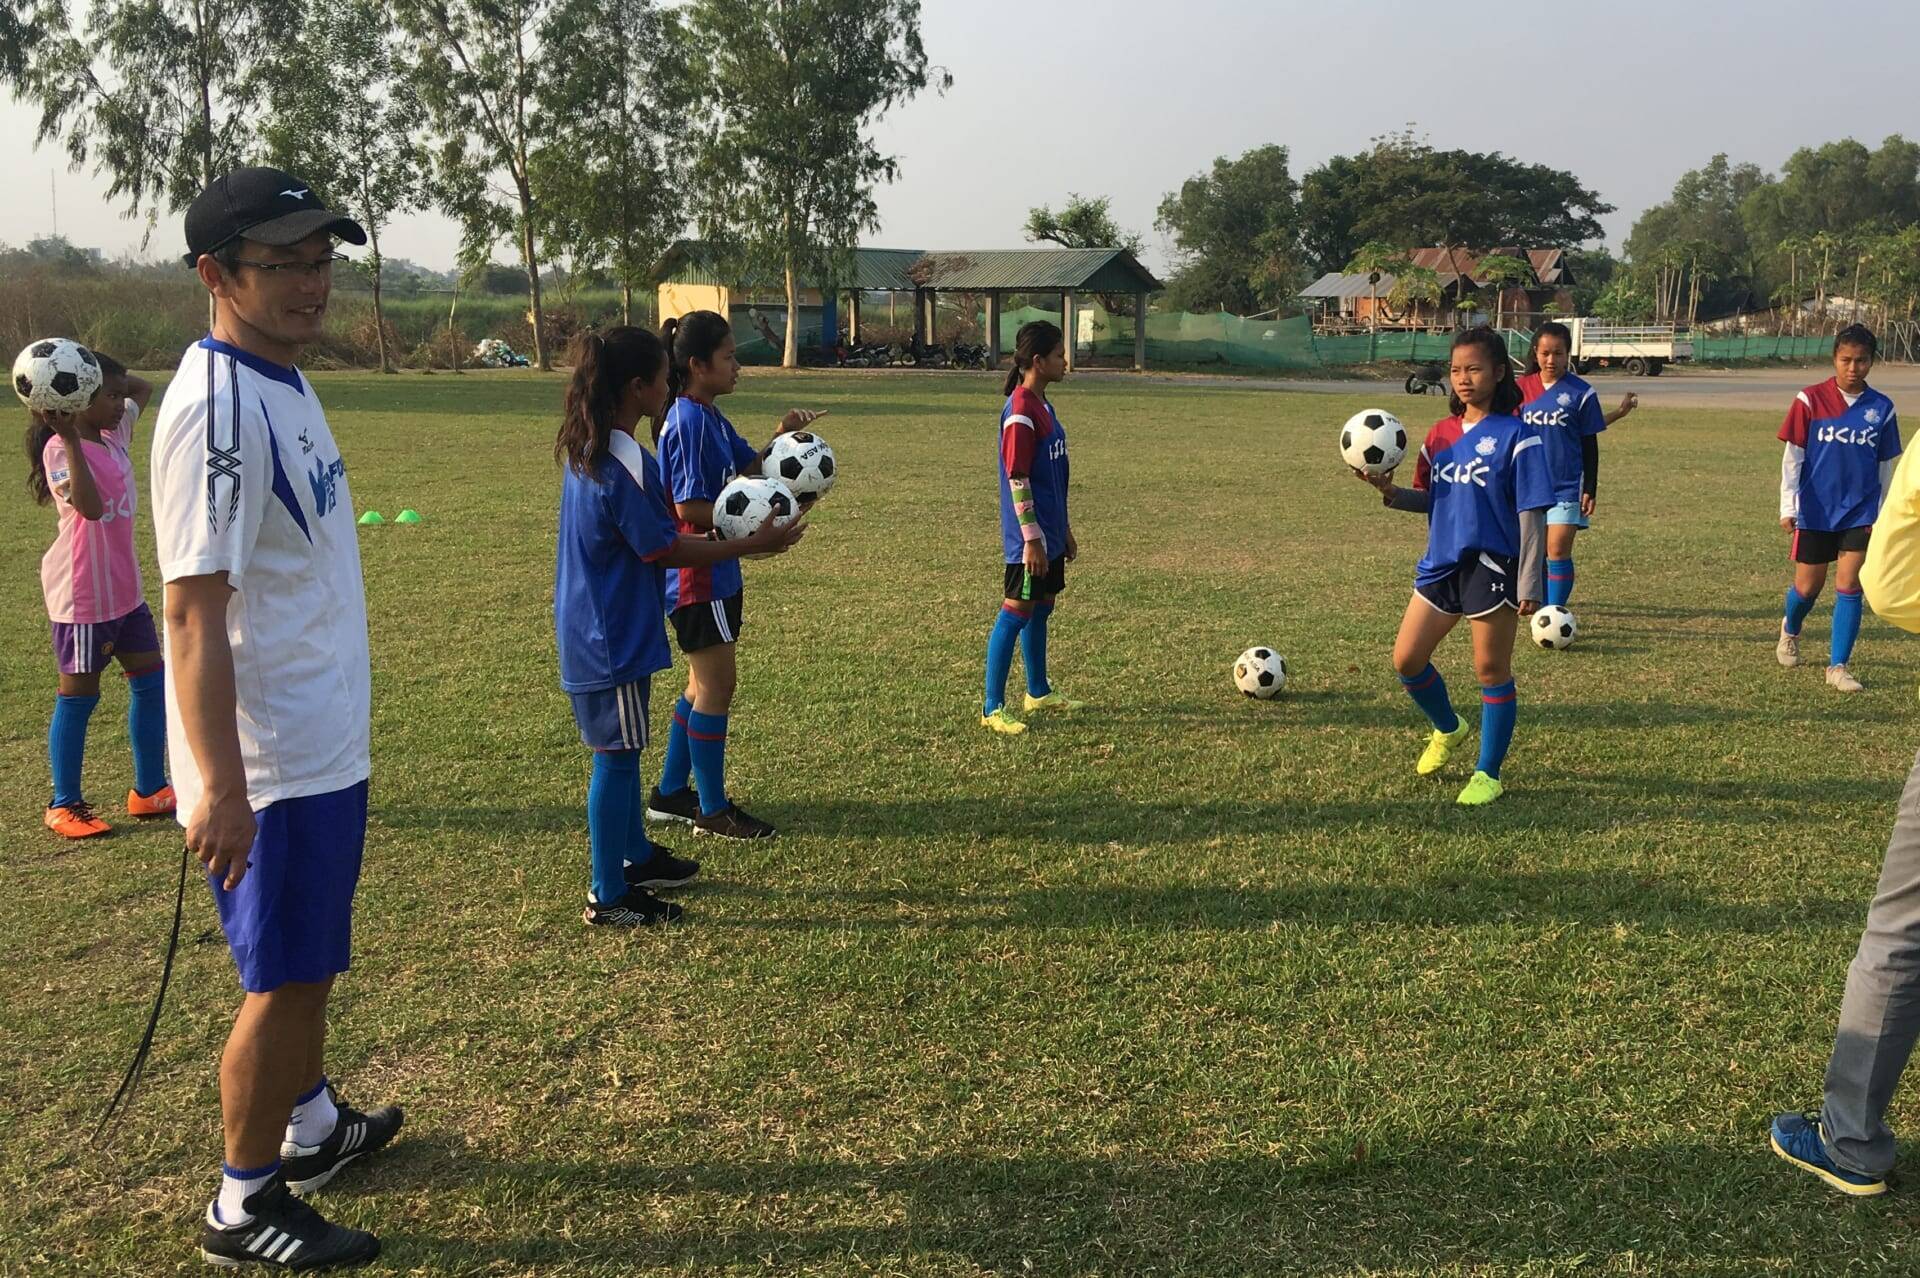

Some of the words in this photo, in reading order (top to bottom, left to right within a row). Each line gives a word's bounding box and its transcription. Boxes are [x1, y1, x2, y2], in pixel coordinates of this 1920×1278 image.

[1523, 407, 1569, 427] はくばく
[1818, 425, 1878, 448] はくばく
[800, 440, 829, 460] KASA
